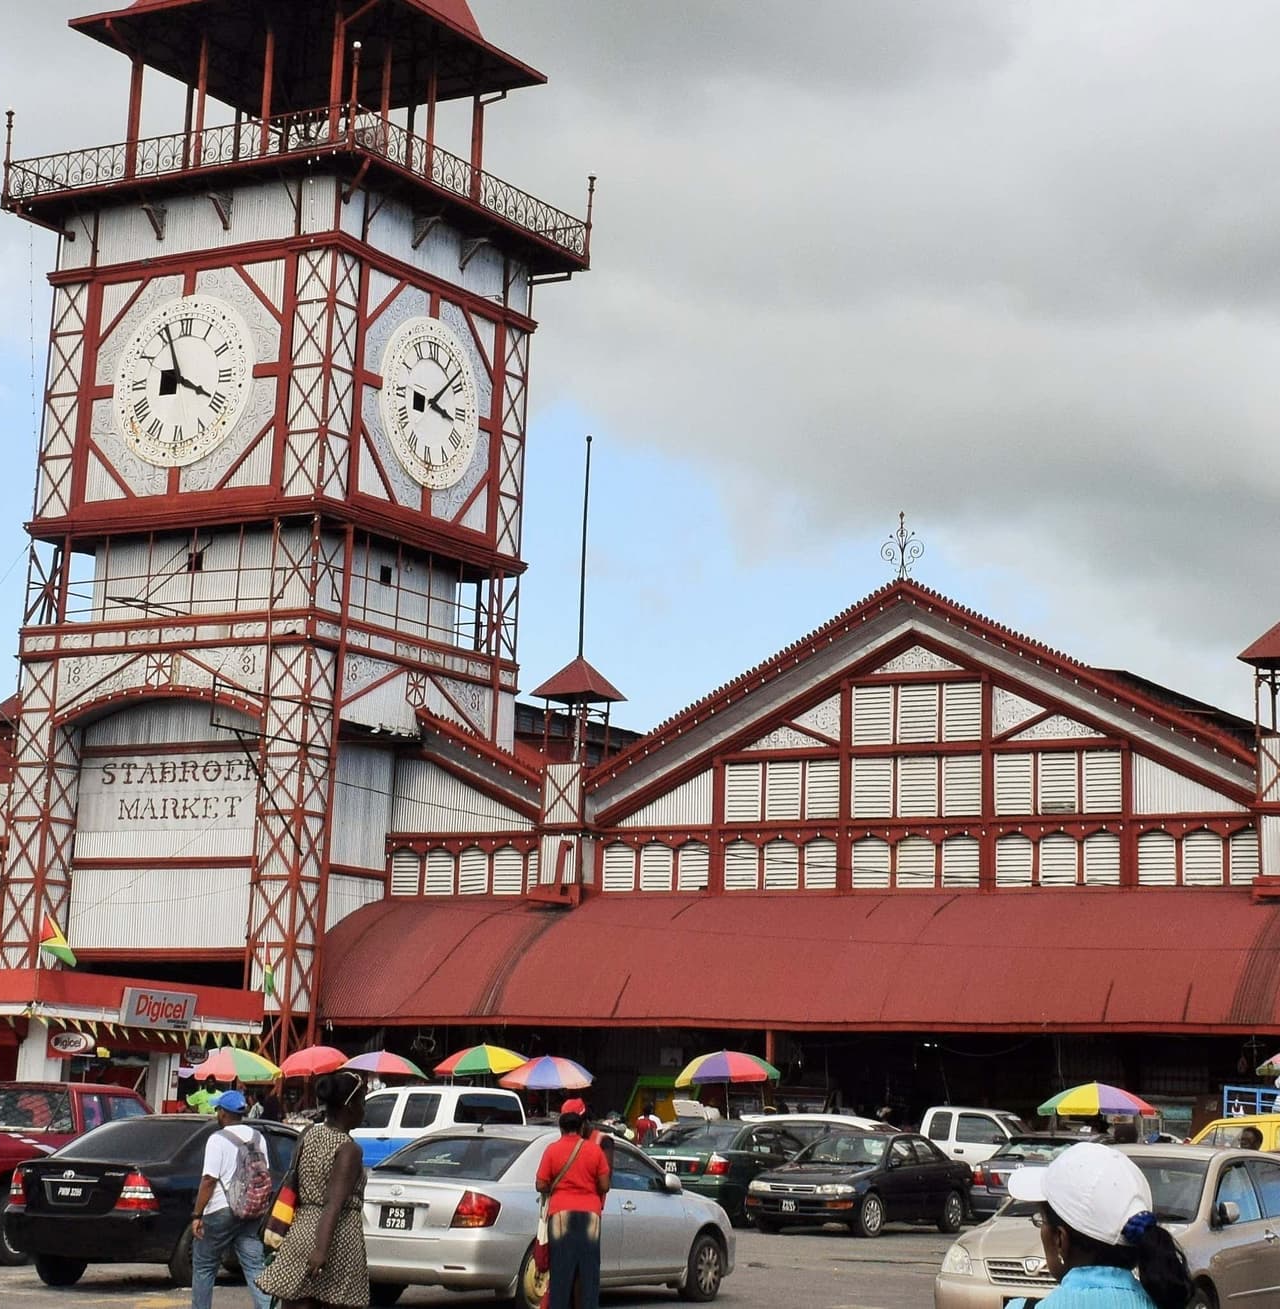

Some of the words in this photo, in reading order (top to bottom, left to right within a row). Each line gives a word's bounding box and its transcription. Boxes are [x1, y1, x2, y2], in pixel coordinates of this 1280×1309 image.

[117, 796, 242, 820] MARKET
[136, 994, 188, 1023] Digicel
[388, 1207, 406, 1218] PSS
[385, 1218, 406, 1229] 5728
